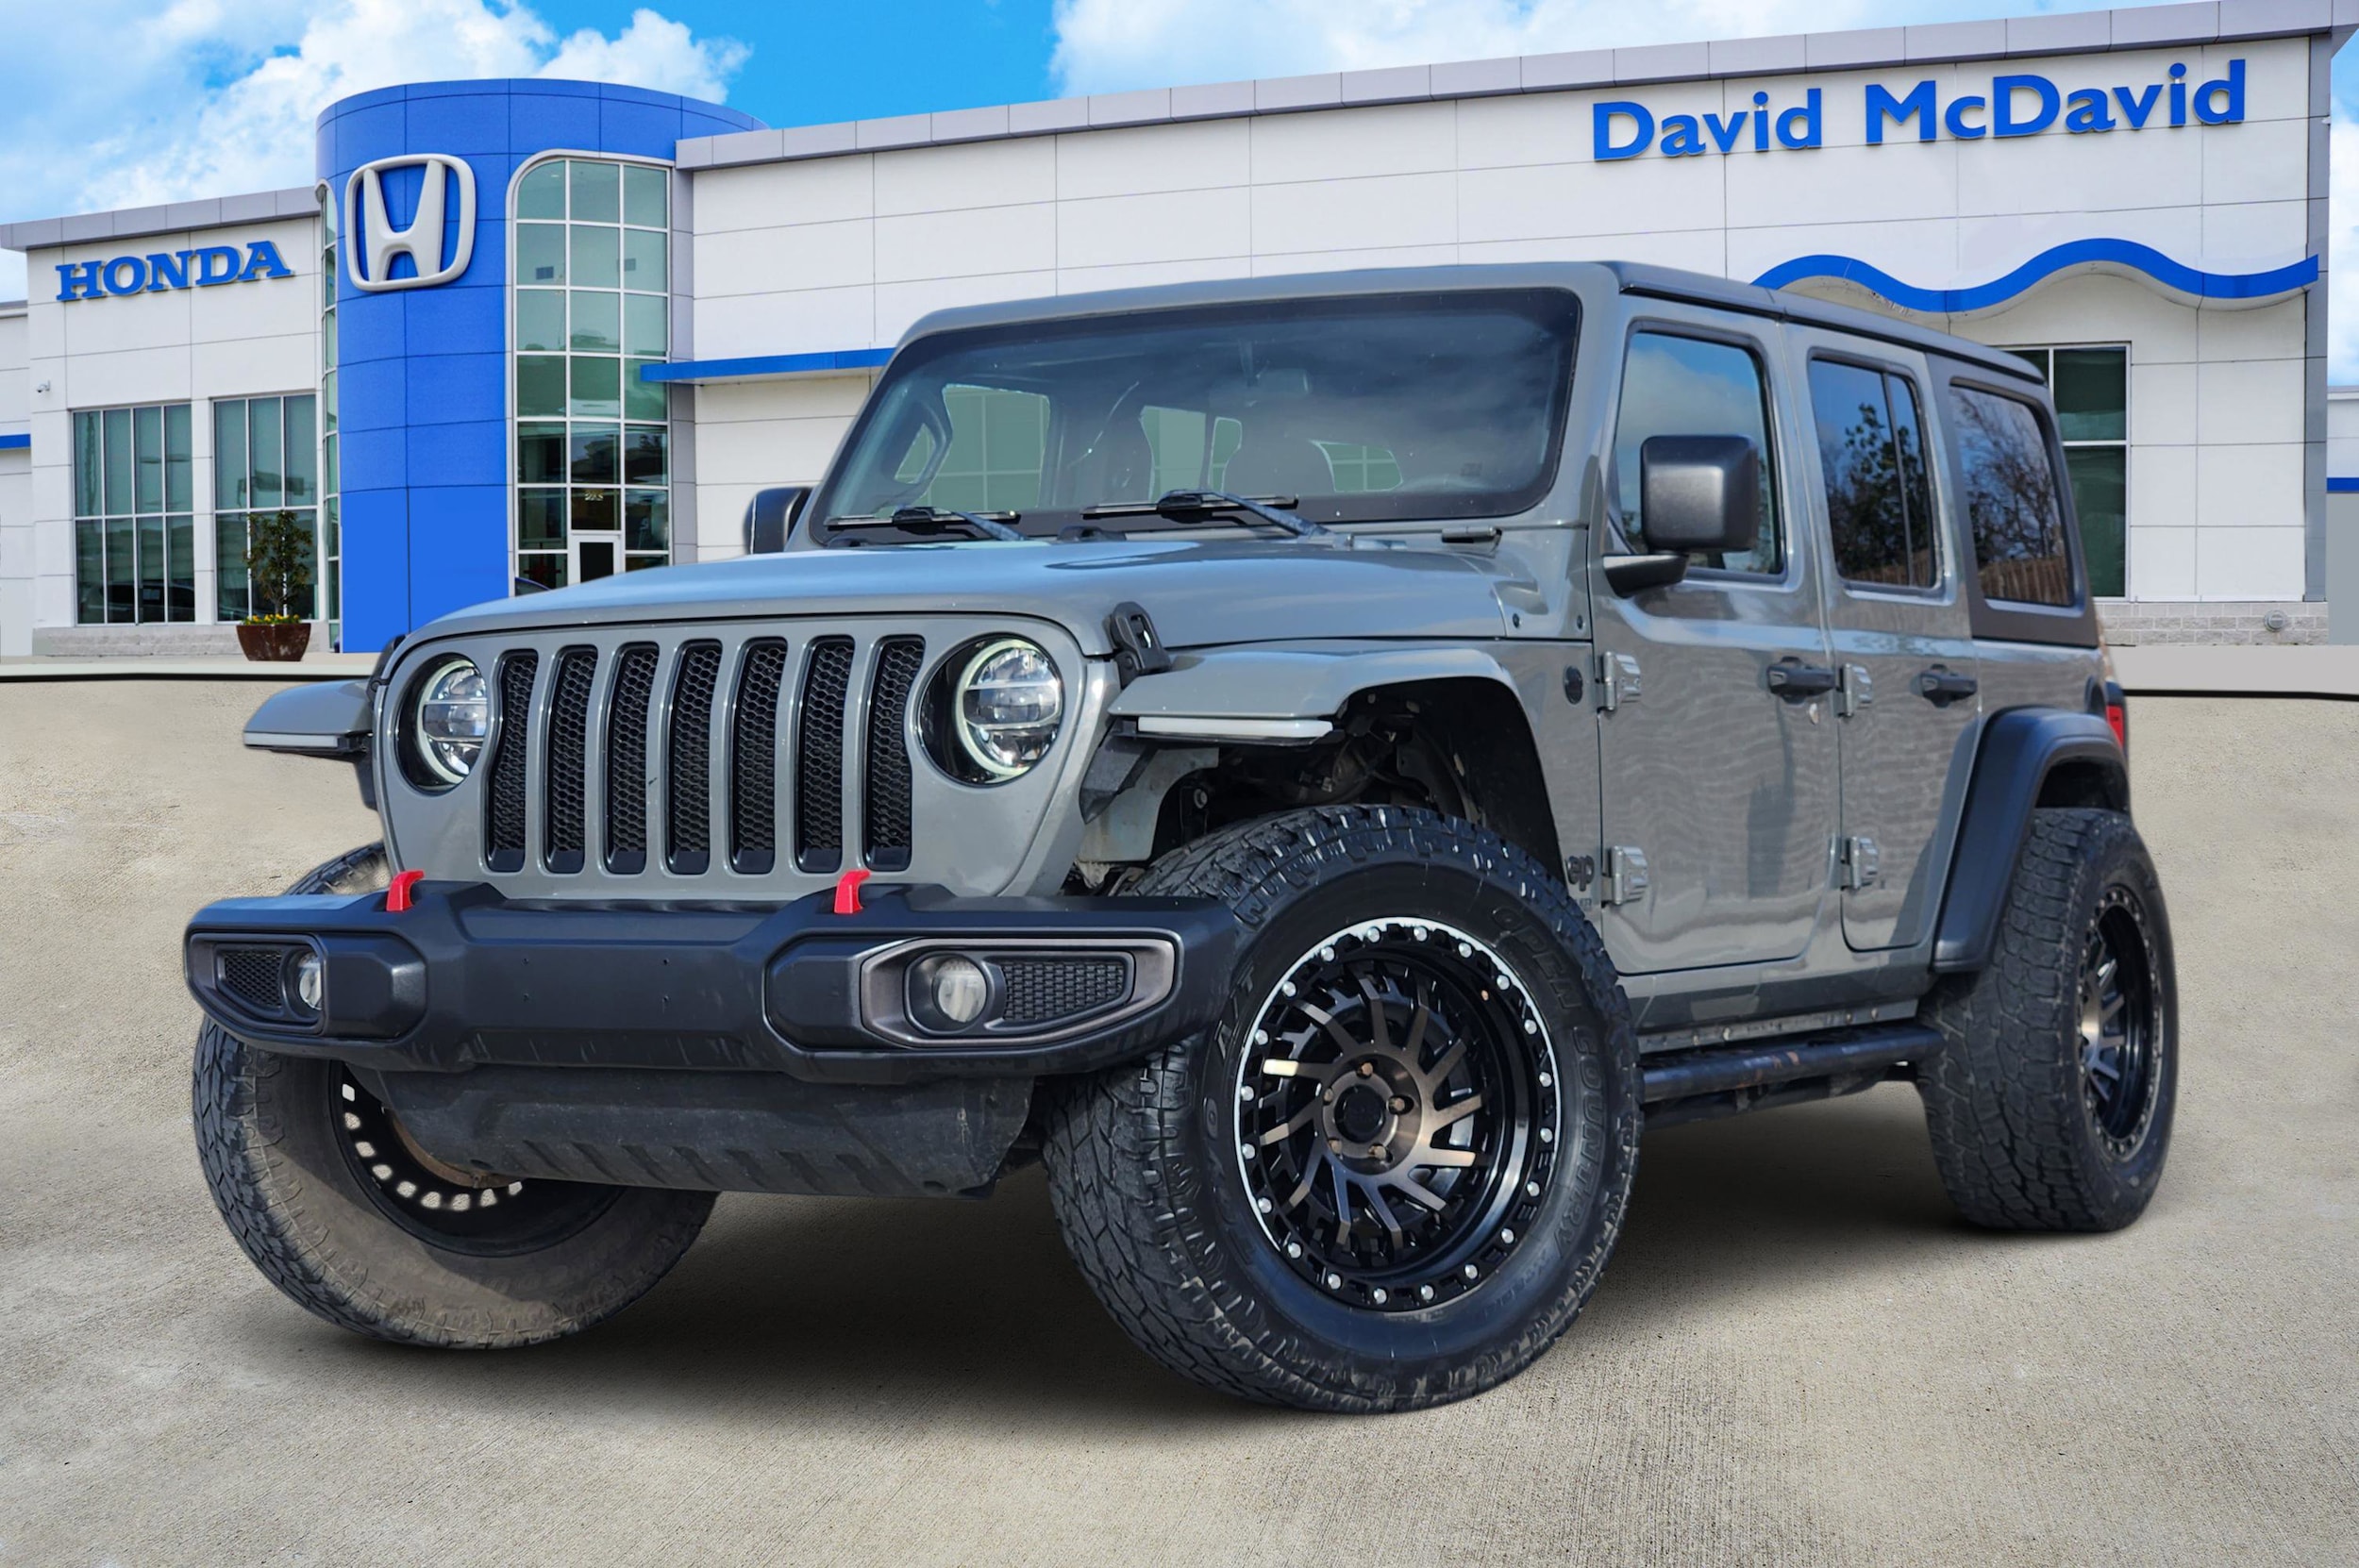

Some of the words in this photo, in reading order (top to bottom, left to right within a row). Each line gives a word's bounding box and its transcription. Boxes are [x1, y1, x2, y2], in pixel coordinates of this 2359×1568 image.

[1593, 88, 1822, 161] David
[1865, 58, 2246, 144] McDavid
[55, 241, 293, 302] HONDA
